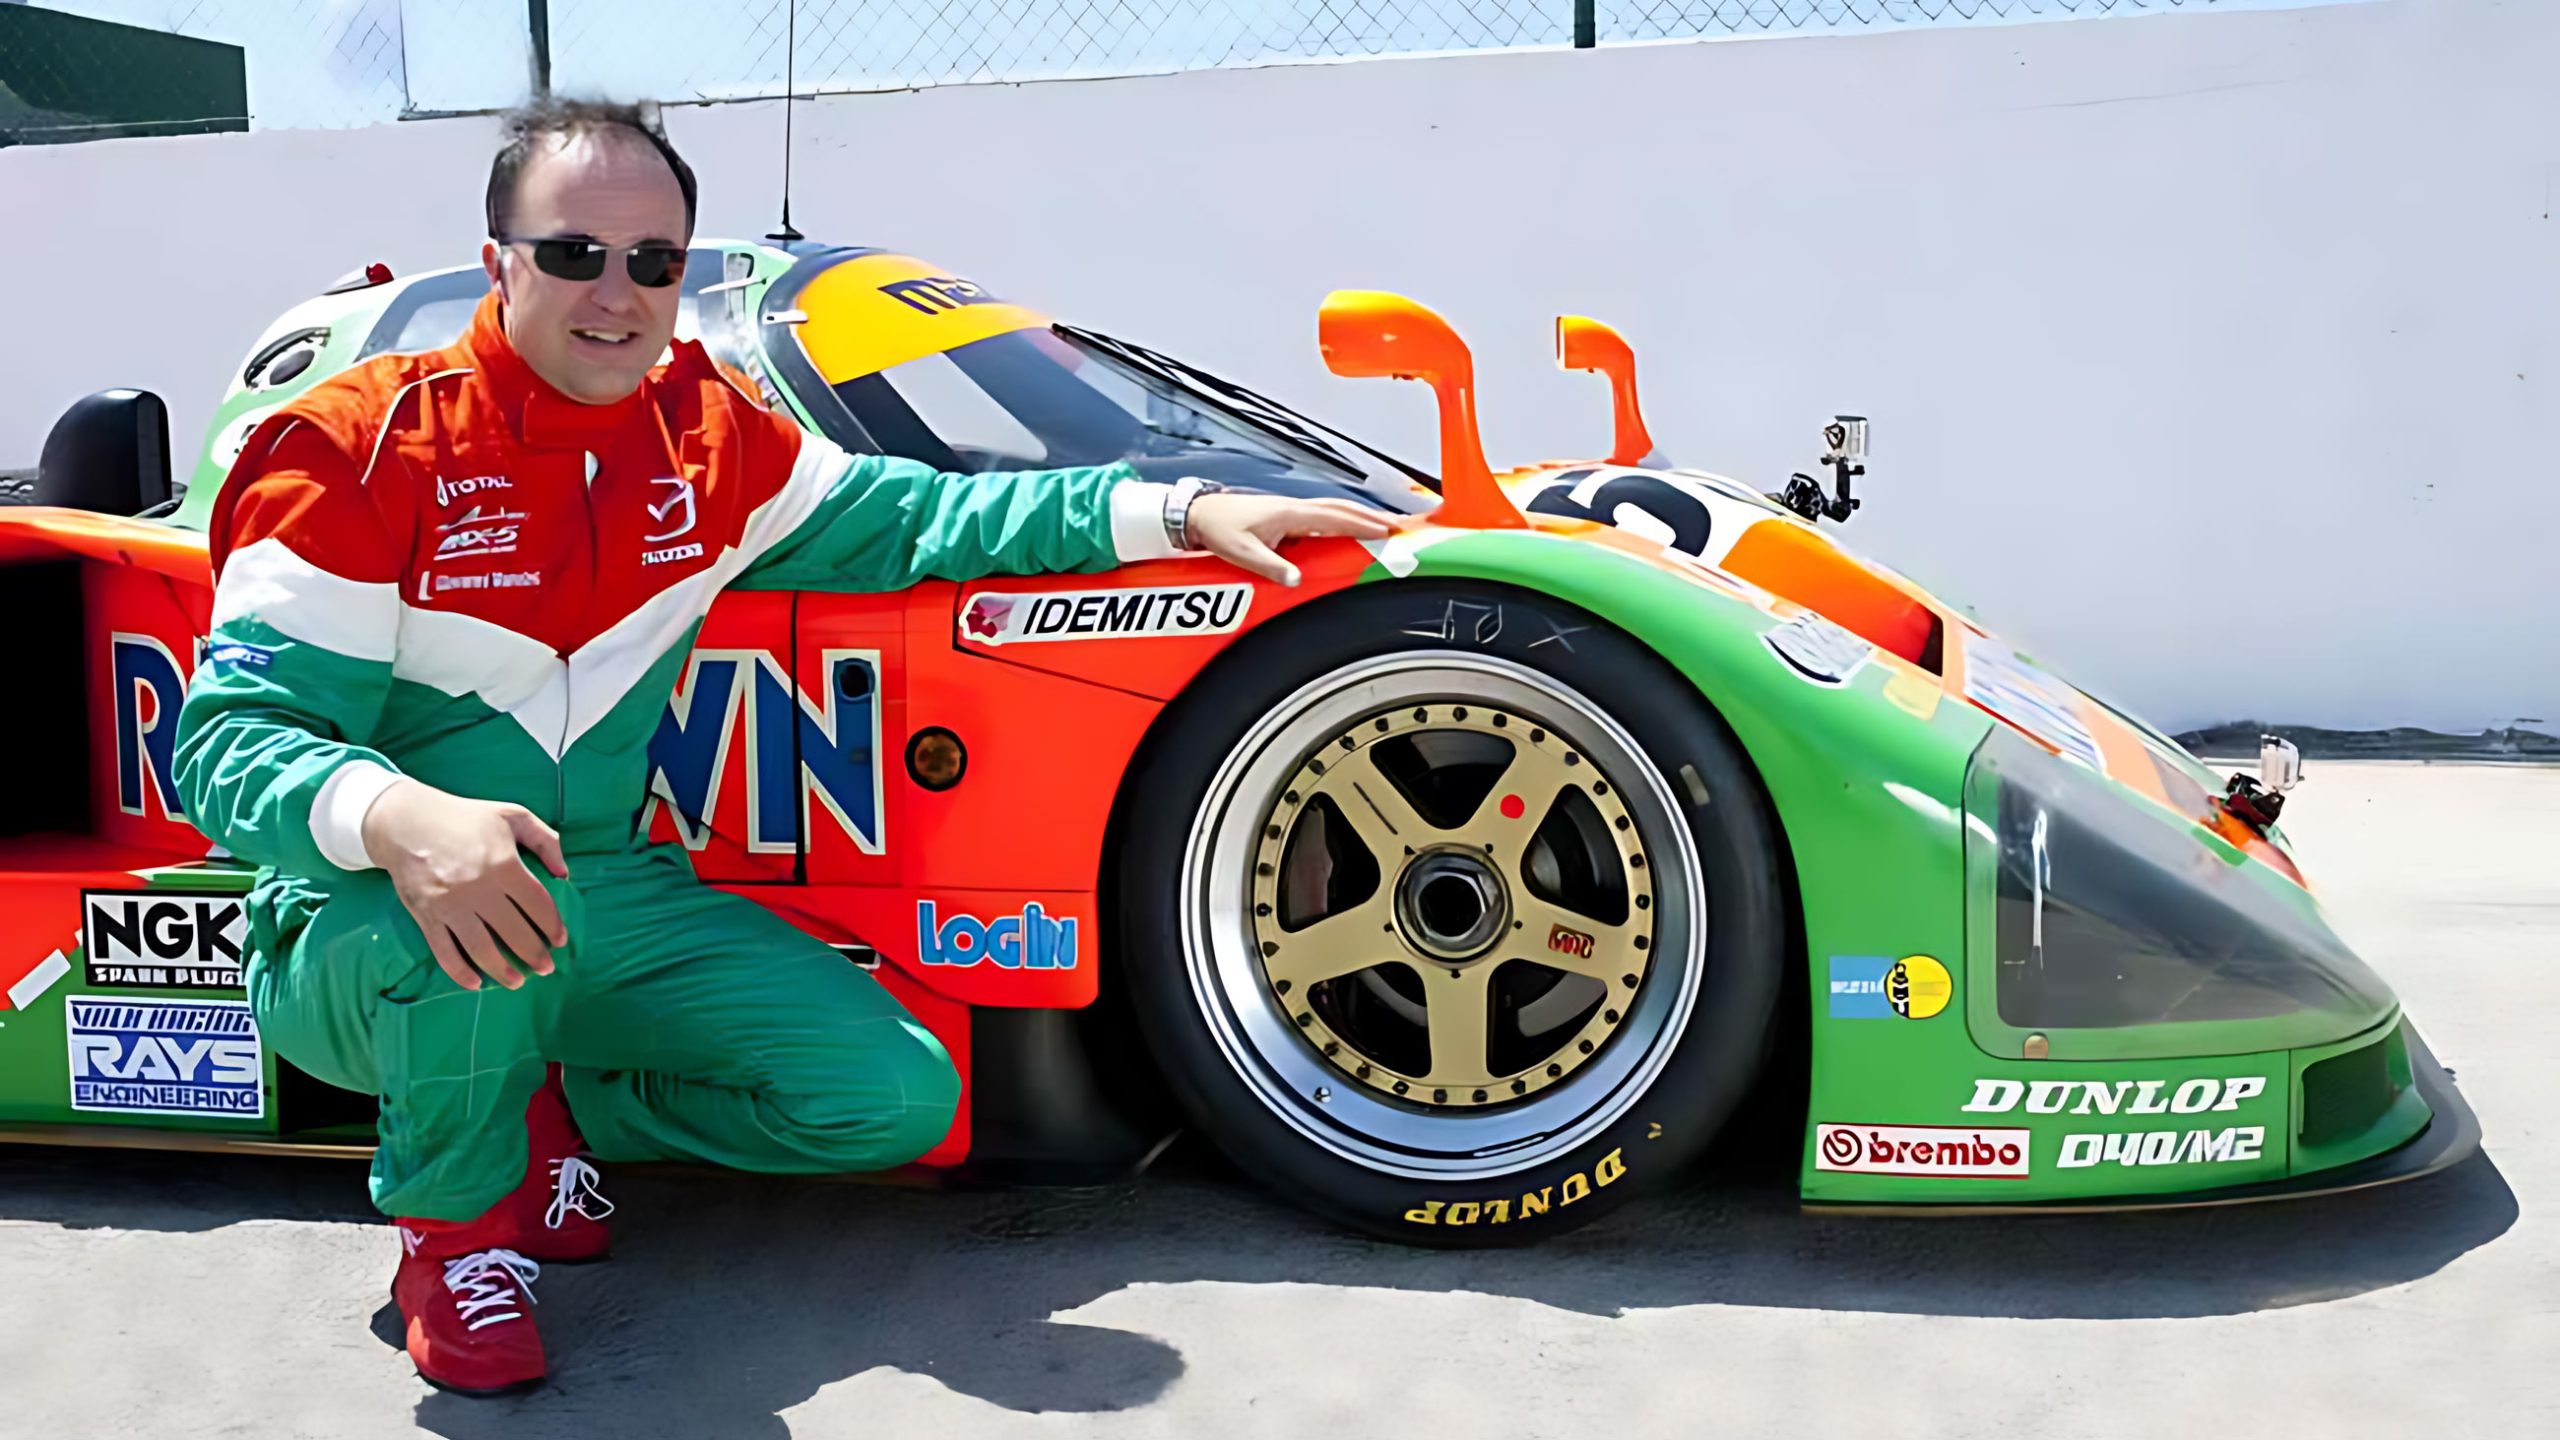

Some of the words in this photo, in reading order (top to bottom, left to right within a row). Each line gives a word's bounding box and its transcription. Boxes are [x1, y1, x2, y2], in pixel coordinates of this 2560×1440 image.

[1022, 589, 1246, 635] IDEMITSU
[91, 900, 242, 963] NGK
[72, 1034, 257, 1084] RAYS
[1961, 1077, 2266, 1115] DUNLOP
[1868, 1132, 2021, 1166] brembo
[1404, 1147, 1627, 1226] DUNLOP
